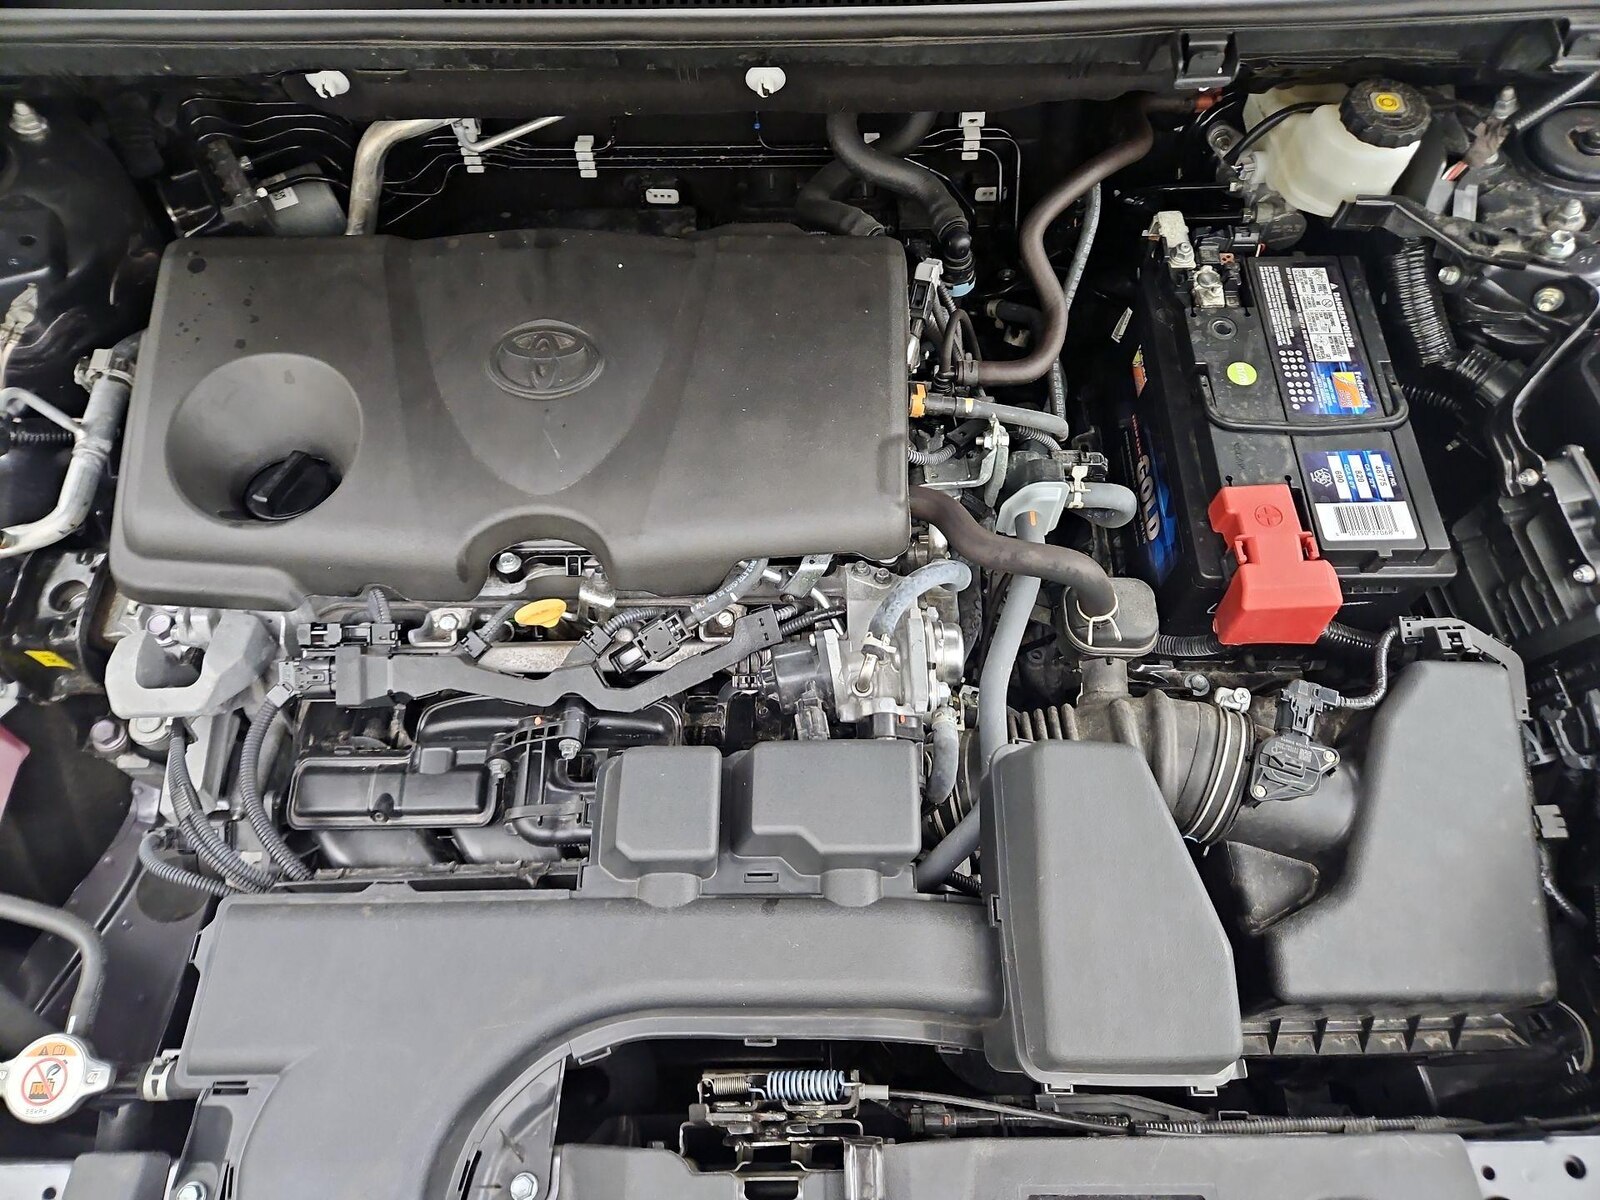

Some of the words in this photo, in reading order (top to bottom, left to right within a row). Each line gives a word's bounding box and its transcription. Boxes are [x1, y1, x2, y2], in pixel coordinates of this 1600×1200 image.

[1333, 292, 1355, 348] DANGER/POISON
[1354, 371, 1371, 408] Federated
[1335, 470, 1344, 484] 690
[1355, 470, 1364, 483] 820
[1375, 466, 1387, 486] 48775
[1136, 454, 1161, 541] GOLD
